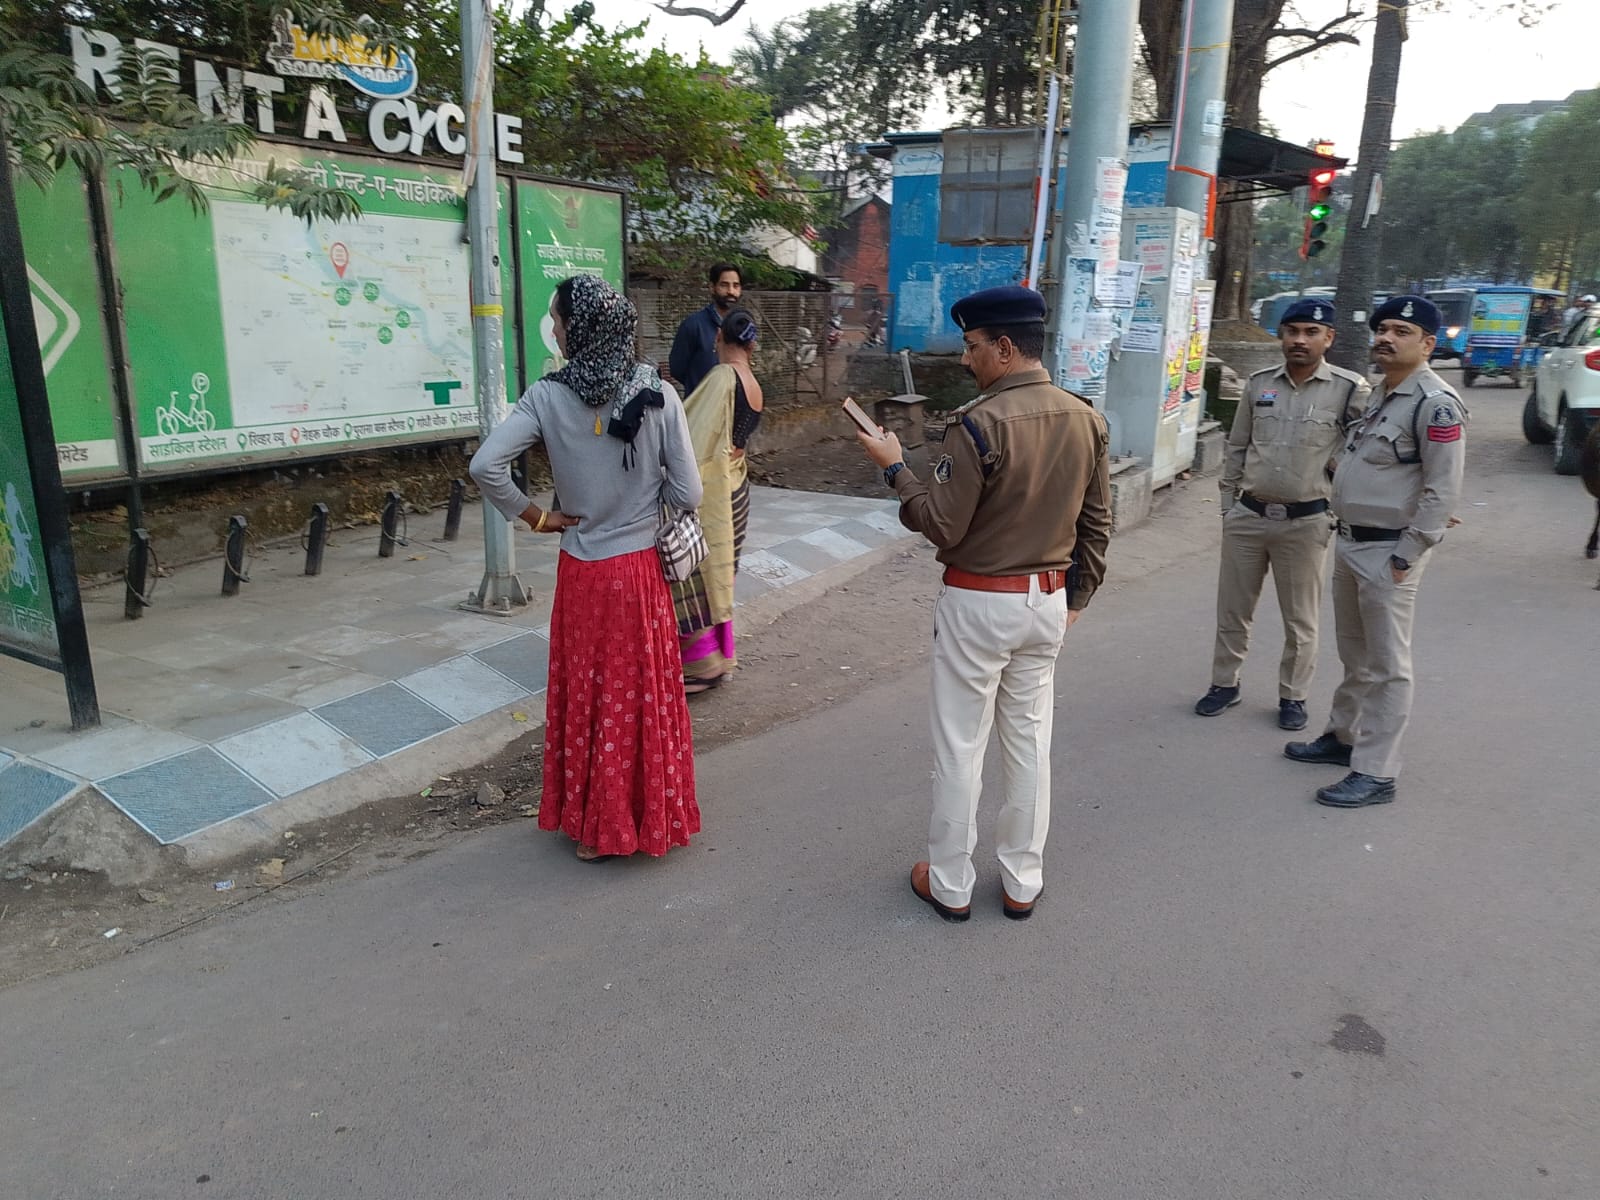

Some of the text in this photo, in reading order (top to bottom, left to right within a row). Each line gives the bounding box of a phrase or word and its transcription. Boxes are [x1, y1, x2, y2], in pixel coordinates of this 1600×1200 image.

[303, 83, 347, 143] A
[368, 97, 525, 164] CYCE
[58, 444, 88, 464] मिटेड
